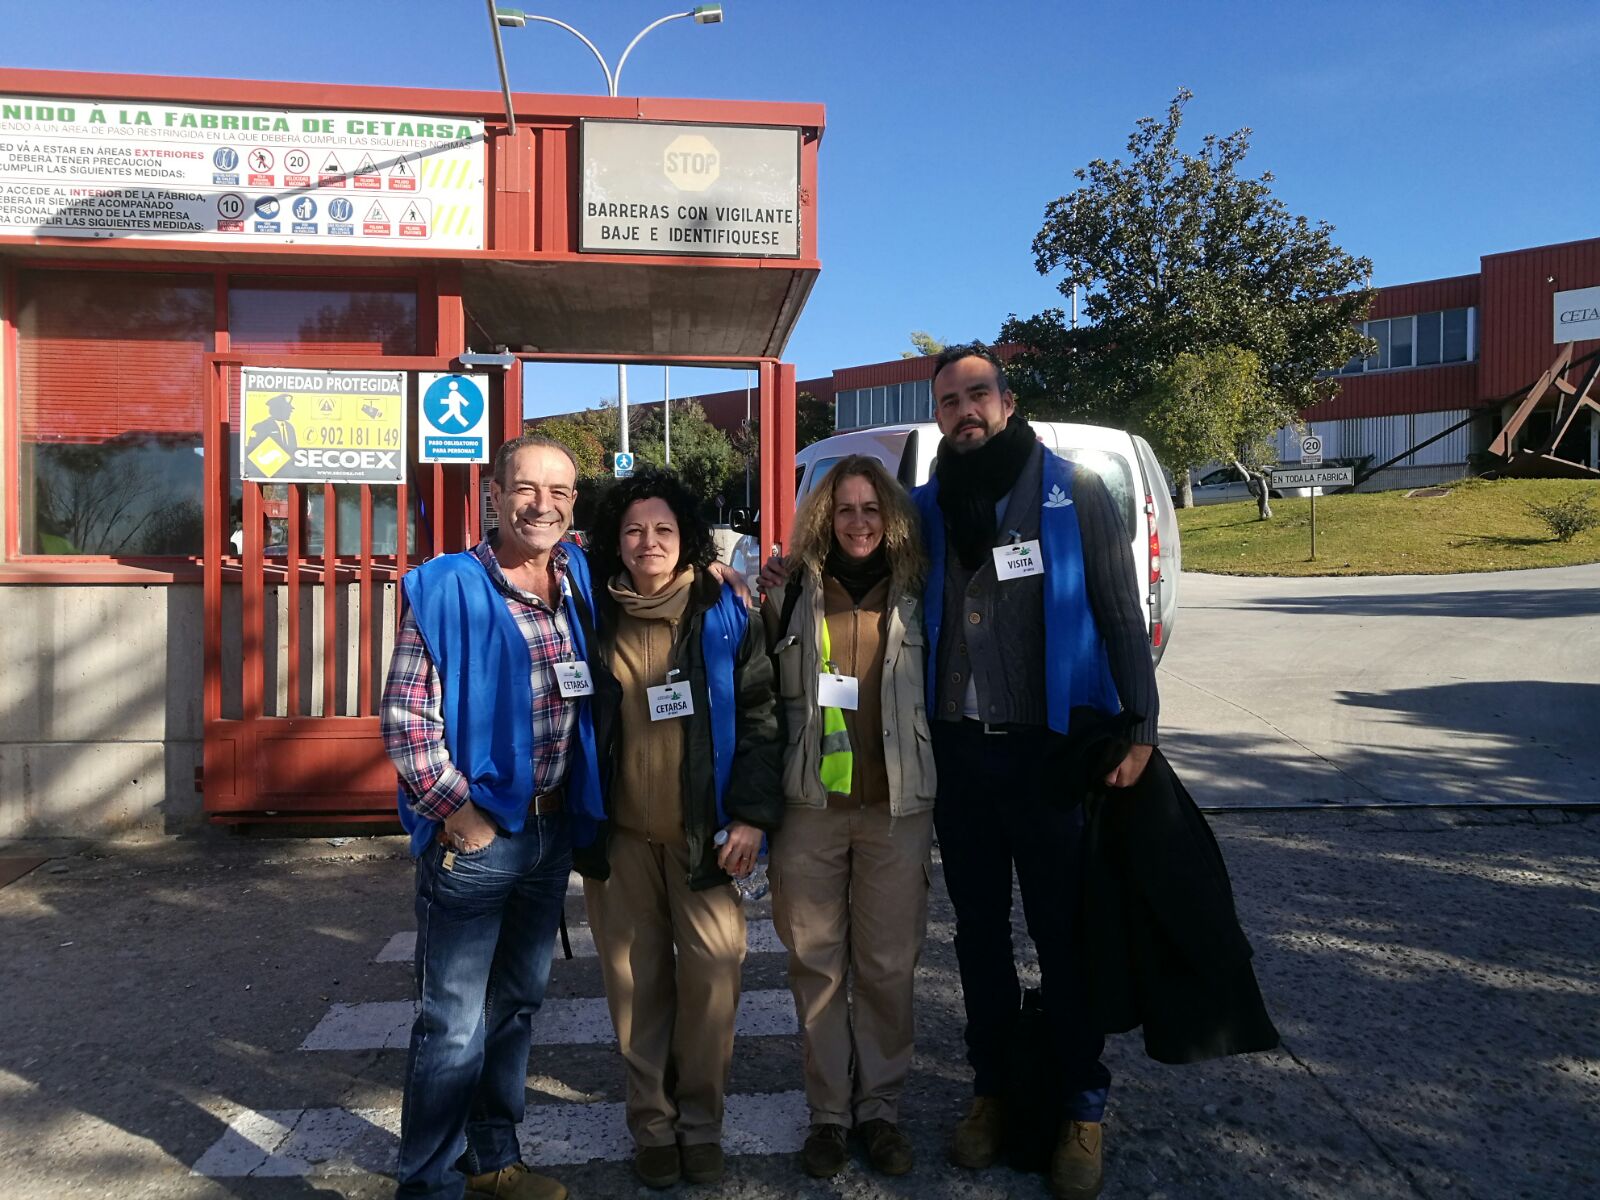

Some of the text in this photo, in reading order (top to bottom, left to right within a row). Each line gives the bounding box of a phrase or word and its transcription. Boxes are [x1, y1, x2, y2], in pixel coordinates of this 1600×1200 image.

[2, 105, 75, 122] NIDO
[89, 109, 106, 124] A
[119, 110, 152, 126] LA
[302, 118, 334, 133] DE
[346, 120, 473, 139] CETARSA
[34, 123, 41, 131] A
[43, 124, 59, 132] UN
[91, 126, 105, 134] DE
[107, 126, 135, 136] PASO
[137, 127, 204, 139] RESTRINGIDA
[206, 131, 221, 140] EN
[222, 132, 236, 141] LA
[238, 132, 259, 142] QUE
[303, 134, 347, 145] CUMPLIR
[349, 136, 368, 146] LAS
[370, 137, 427, 148] SIGUIENTES
[33, 144, 41, 153] A
[43, 145, 77, 154] ESTAR
[80, 146, 94, 155] EN
[134, 149, 205, 160] EXTERIORES
[56, 155, 90, 165] TENER
[290, 156, 304, 168] 20
[666, 152, 717, 174] STOP
[47, 165, 67, 174] LAS
[69, 165, 132, 176] SIGUIENTES
[134, 168, 186, 178] MEDIDAS:
[7, 186, 51, 195] ACCEDE
[54, 187, 66, 196] AL
[69, 188, 122, 198] INTERIOR
[124, 190, 139, 199] DE
[142, 190, 155, 200] LA
[35, 197, 46, 205] IR
[49, 197, 96, 207] SIEMPRE
[98, 198, 173, 210] ACOMPAÑADO
[222, 200, 239, 213] 10
[56, 207, 103, 217] INTERNO
[106, 209, 120, 218] DE
[123, 210, 136, 218] LA
[139, 210, 190, 220] EMPRESA
[588, 203, 793, 224] BARRERAS CON VIGILANTE
[14, 215, 63, 225] CUMPLIR
[66, 217, 86, 226] LAS
[88, 218, 151, 228] SIGUIENTES
[153, 220, 204, 231] MEDIDAS:
[601, 226, 780, 246] BAJE E IDENTIFIQUESE
[248, 374, 400, 393] PROPIEDAD PROTEGIDA
[320, 426, 399, 447] 902 181 149
[1305, 441, 1318, 451] 20
[294, 450, 397, 470] SECOEX
[1272, 475, 1283, 484] EN
[1317, 472, 1349, 482] FABRICA
[1007, 557, 1034, 570] VISITA
[563, 680, 590, 690] CETARSA
[656, 700, 688, 714] CETARSA
